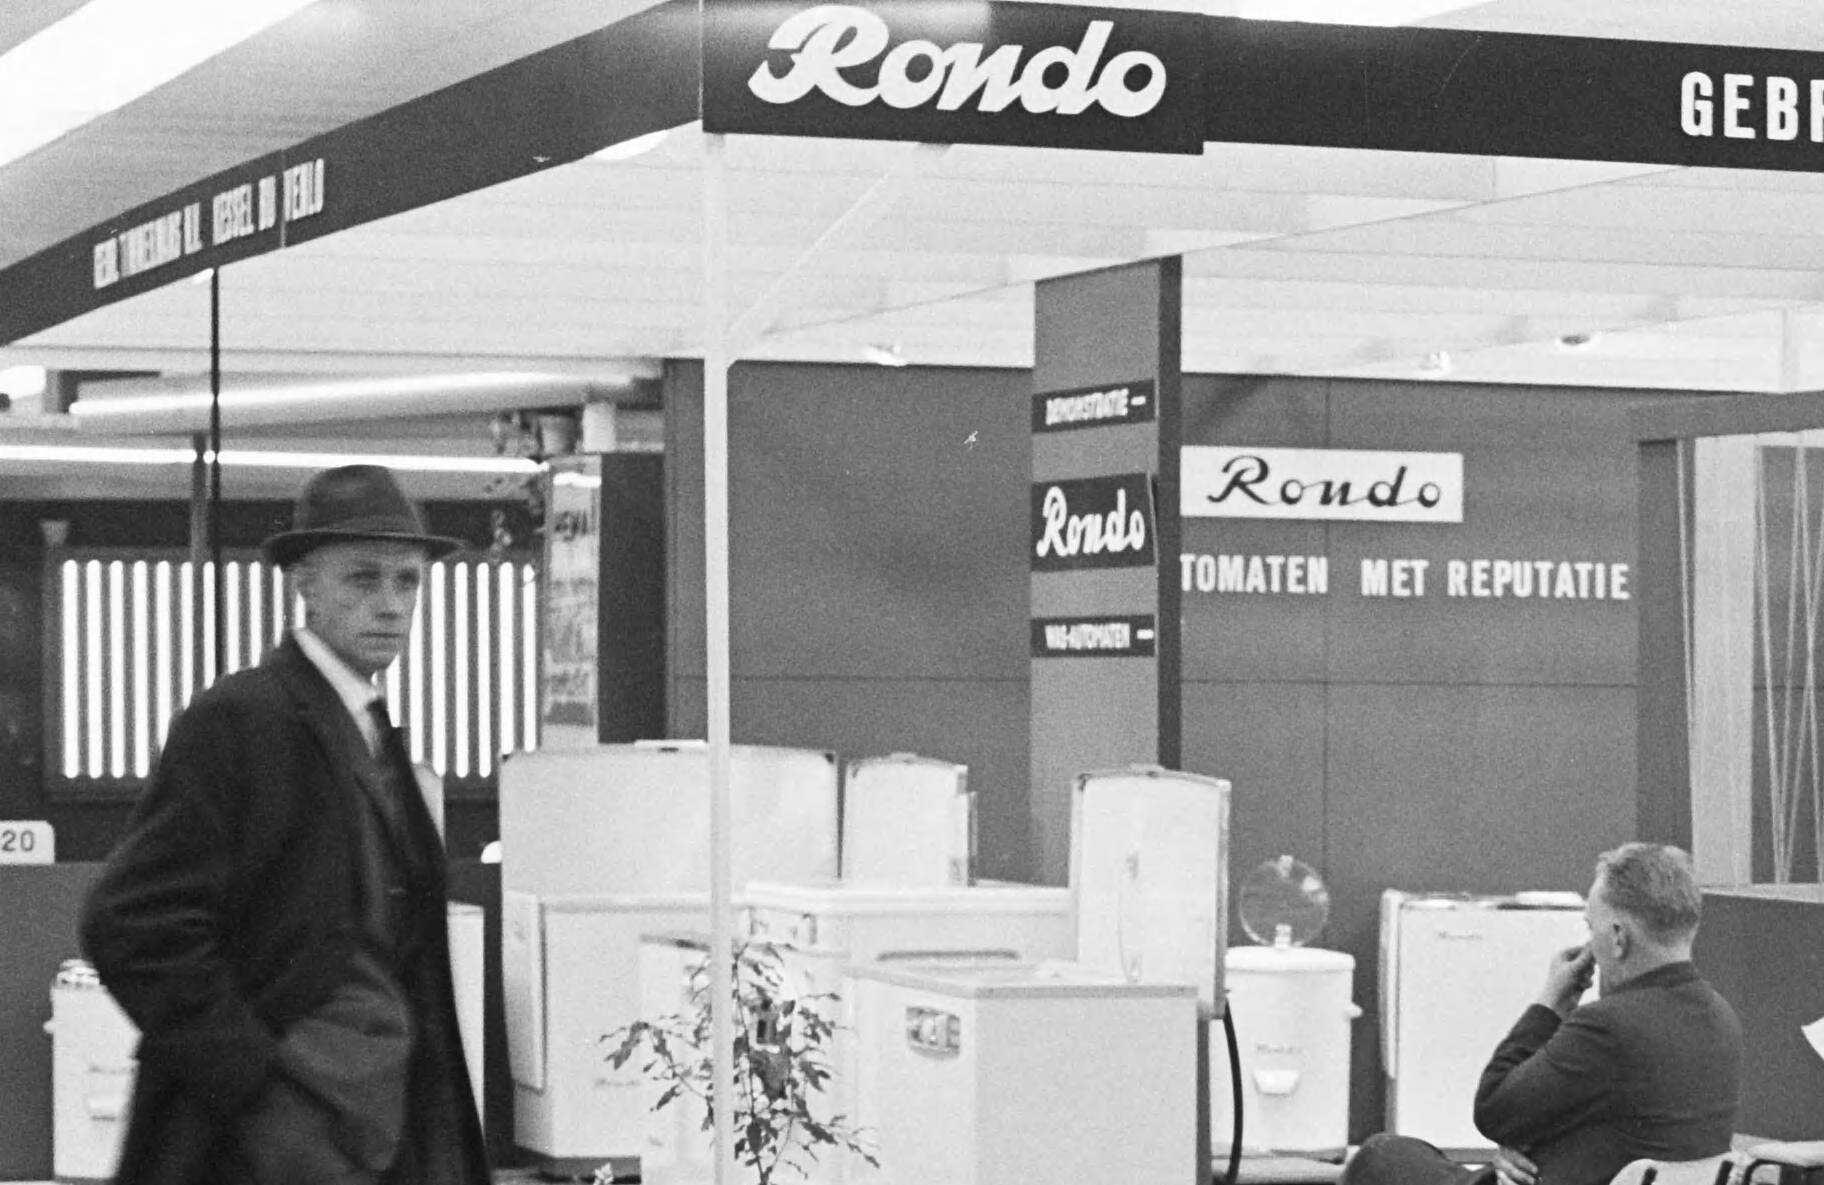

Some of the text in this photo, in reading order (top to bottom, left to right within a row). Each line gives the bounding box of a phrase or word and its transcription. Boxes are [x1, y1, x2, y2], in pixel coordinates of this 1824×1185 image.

[748, 5, 1166, 117] Rondo
[1207, 454, 1442, 508] Rondo
[1036, 486, 1145, 557] Rondo
[1361, 558, 1430, 597] MET
[1447, 560, 1631, 600] REPUTATIE
